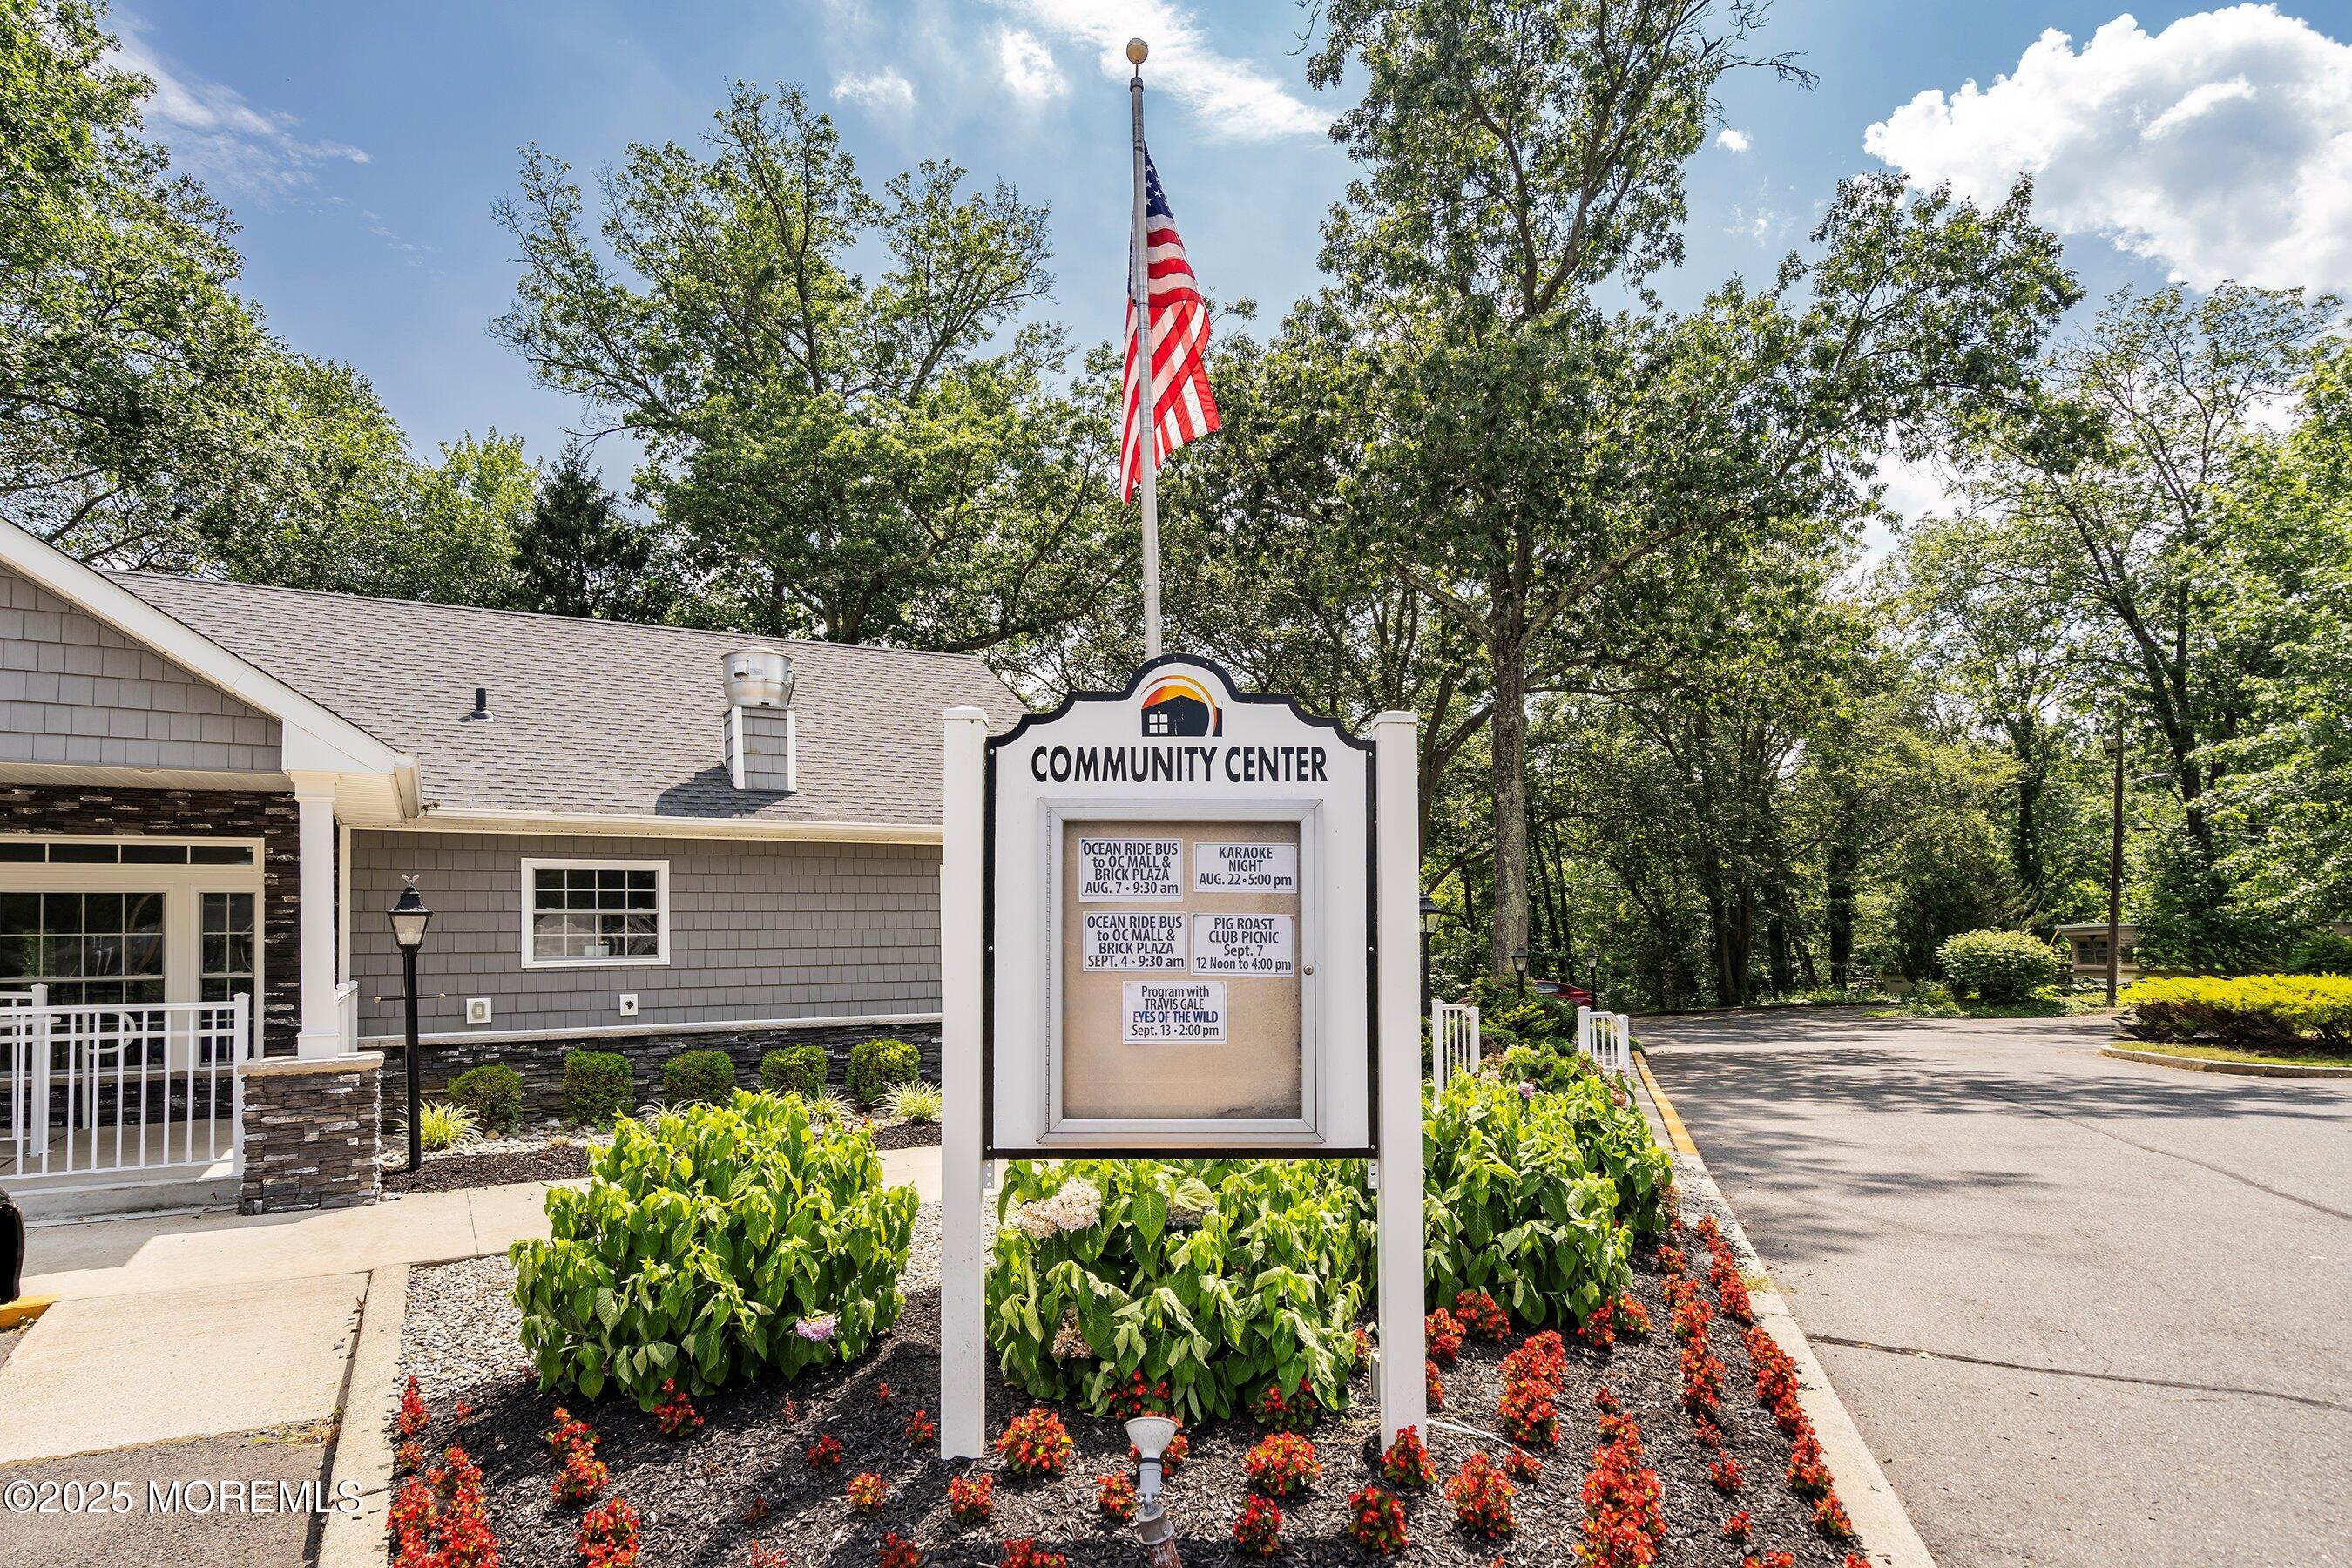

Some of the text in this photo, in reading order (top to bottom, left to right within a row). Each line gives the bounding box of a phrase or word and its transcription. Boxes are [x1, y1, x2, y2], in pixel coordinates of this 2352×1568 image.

[1031, 745, 1328, 783] COMMUNITY CENTER
[1083, 843, 1178, 855] OCEAN RIDE BUS
[1220, 847, 1273, 859] KARAOKE
[1092, 855, 1171, 868] to OC MALL &
[1229, 860, 1263, 872] NIGHT
[1095, 868, 1169, 880] BRICK PLAZA
[1200, 873, 1292, 889] AUG. 22 5:00 pm
[1085, 882, 1178, 894] AUG. 7 9:30 am
[1087, 916, 1182, 928] OCEAN RIDE BUS
[1214, 918, 1274, 930] PIG ROAST
[1097, 929, 1175, 941] to OC MALL &
[1209, 930, 1279, 943] CLUB PICNIC
[1099, 943, 1173, 954] BRICK PLAZA
[1224, 944, 1263, 959] Sept. 7
[1088, 956, 1184, 967] SEPT. 4 9:30 am
[1196, 957, 1291, 972] 12 Noon to 4:00 pm
[1142, 986, 1209, 999] Program with
[1145, 998, 1204, 1010] TRAVIS GALE
[1133, 1011, 1218, 1023] EYES OF THE WILD
[1132, 1024, 1219, 1038] Sept. 13 2:00 pm
